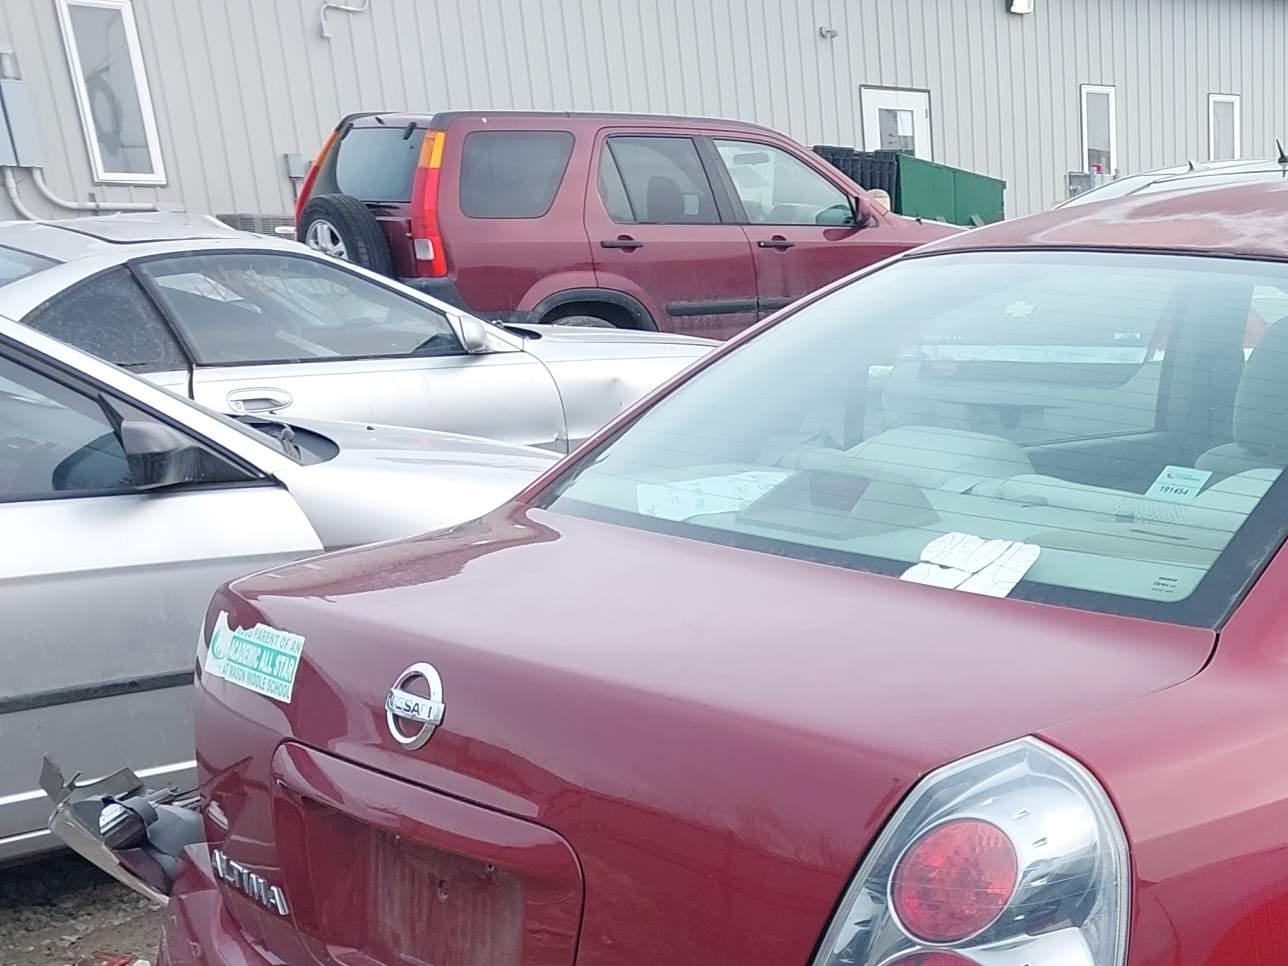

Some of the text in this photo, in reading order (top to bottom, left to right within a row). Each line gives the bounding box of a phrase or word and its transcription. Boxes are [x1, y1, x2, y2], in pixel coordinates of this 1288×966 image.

[277, 635, 291, 650] OF
[258, 648, 275, 674] ALL
[272, 653, 295, 680] STAR
[266, 677, 290, 699] SCHOOL
